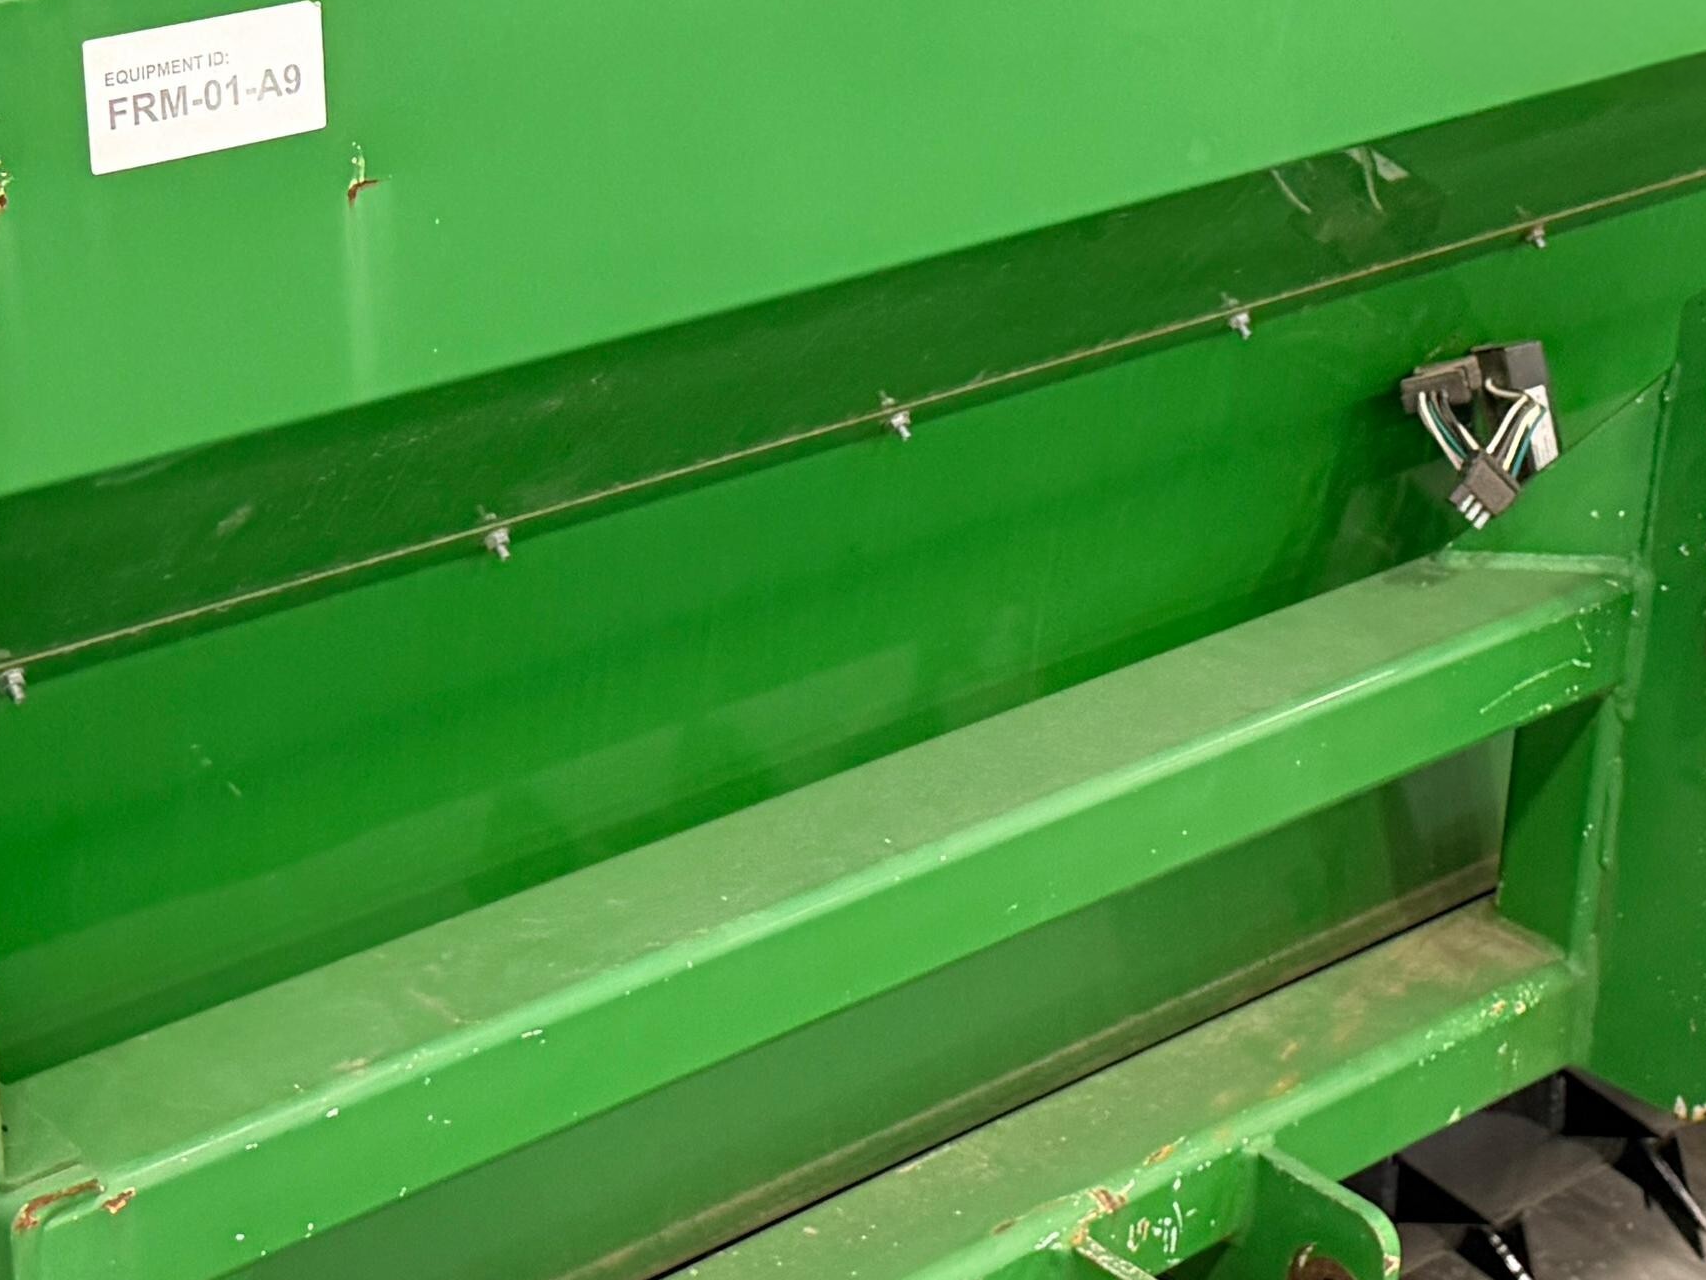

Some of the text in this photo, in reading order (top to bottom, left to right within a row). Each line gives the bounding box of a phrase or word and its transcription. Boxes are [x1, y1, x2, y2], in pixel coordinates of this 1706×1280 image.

[104, 50, 230, 87] EQUIPMENT ID:
[108, 63, 303, 131] FRM-01-A9
